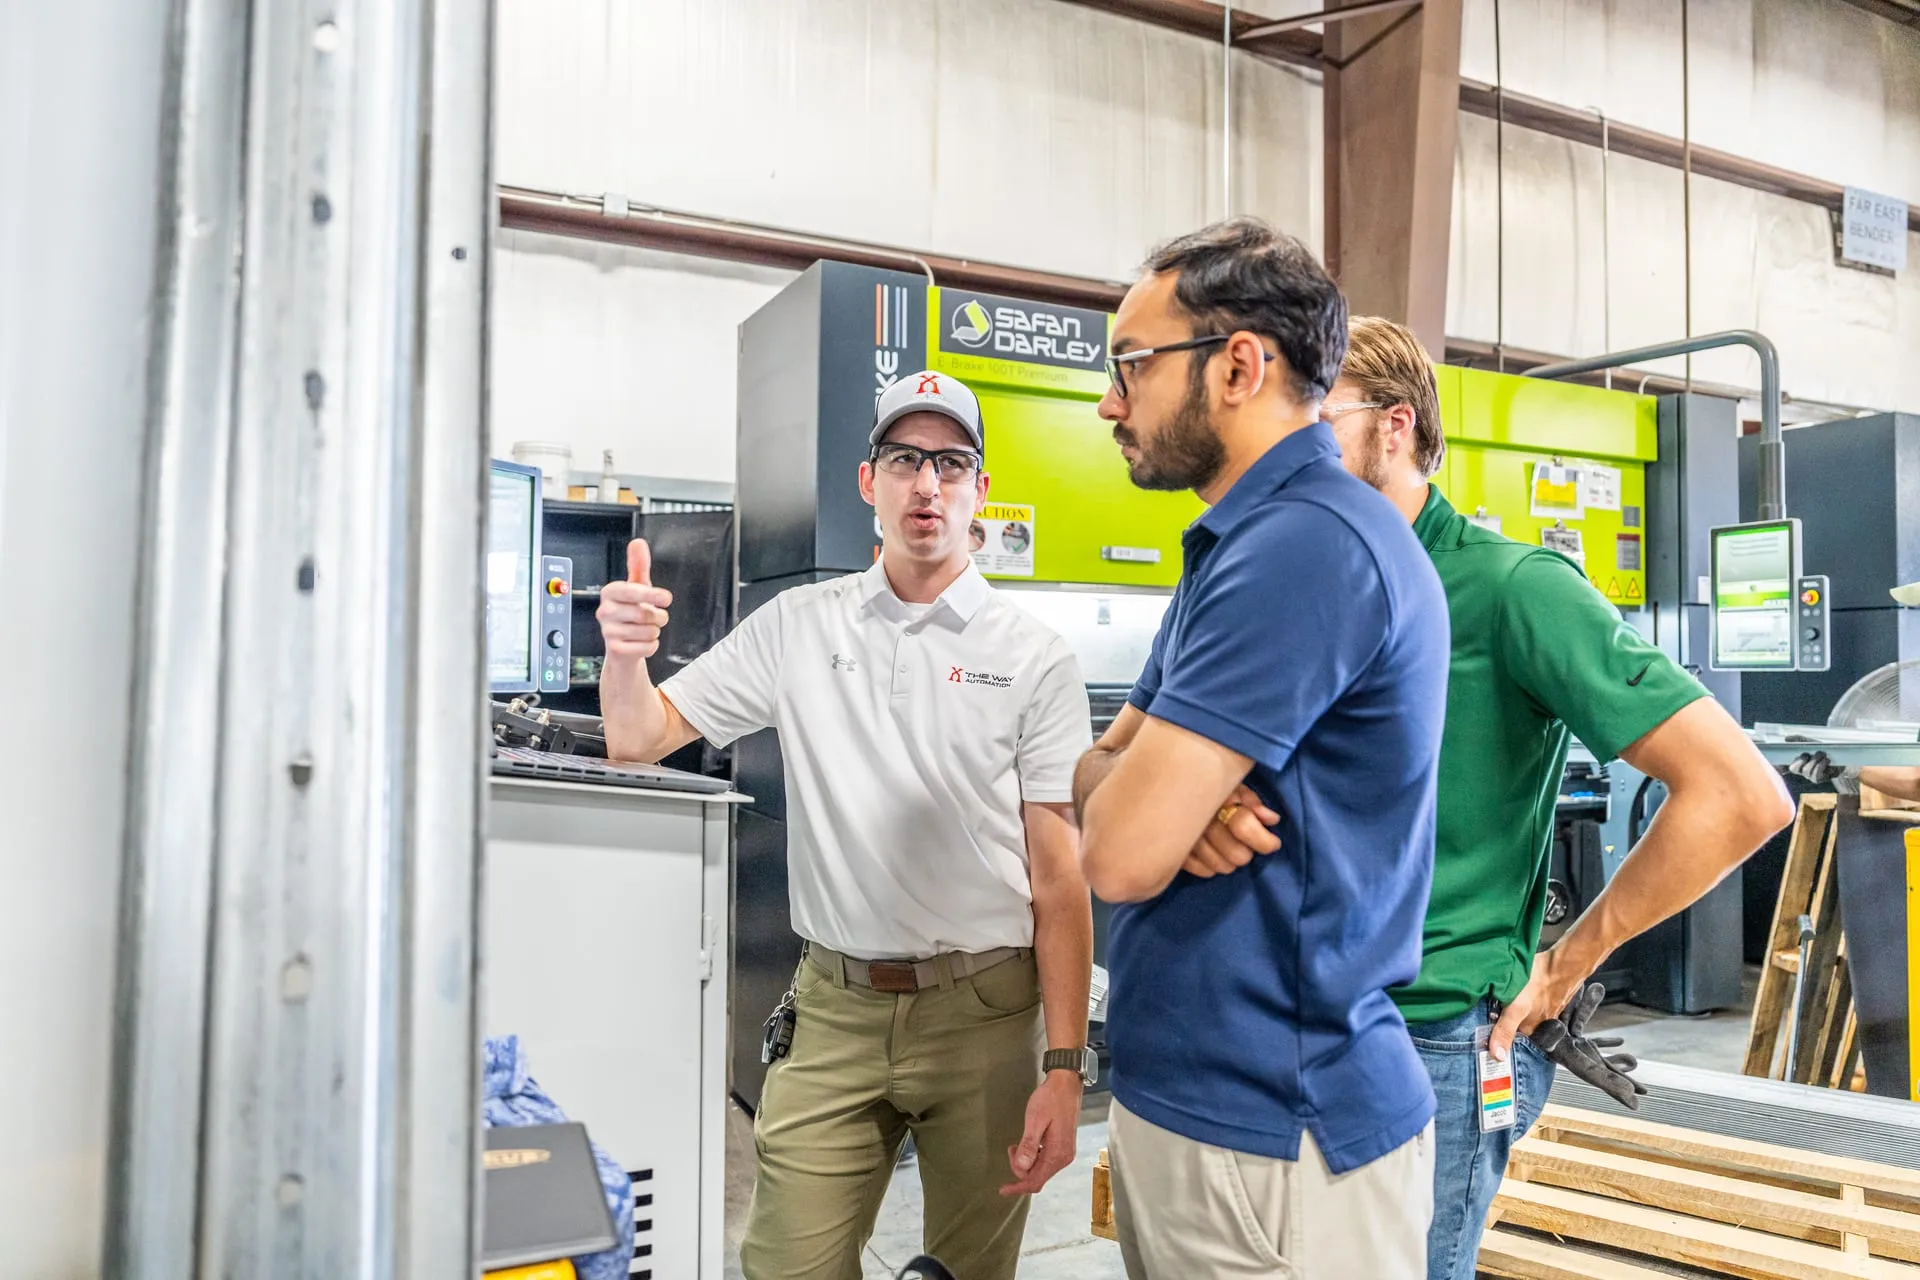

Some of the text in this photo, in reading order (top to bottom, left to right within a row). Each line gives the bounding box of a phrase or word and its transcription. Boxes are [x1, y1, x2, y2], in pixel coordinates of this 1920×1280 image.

[1848, 196, 1903, 223] FAR EAST
[995, 306, 1081, 339] SAFAN
[994, 330, 1101, 363] DARLEY
[1017, 366, 1069, 382] Premium
[965, 672, 1015, 683] THE WAY
[965, 678, 1011, 688] AUTOMATION
